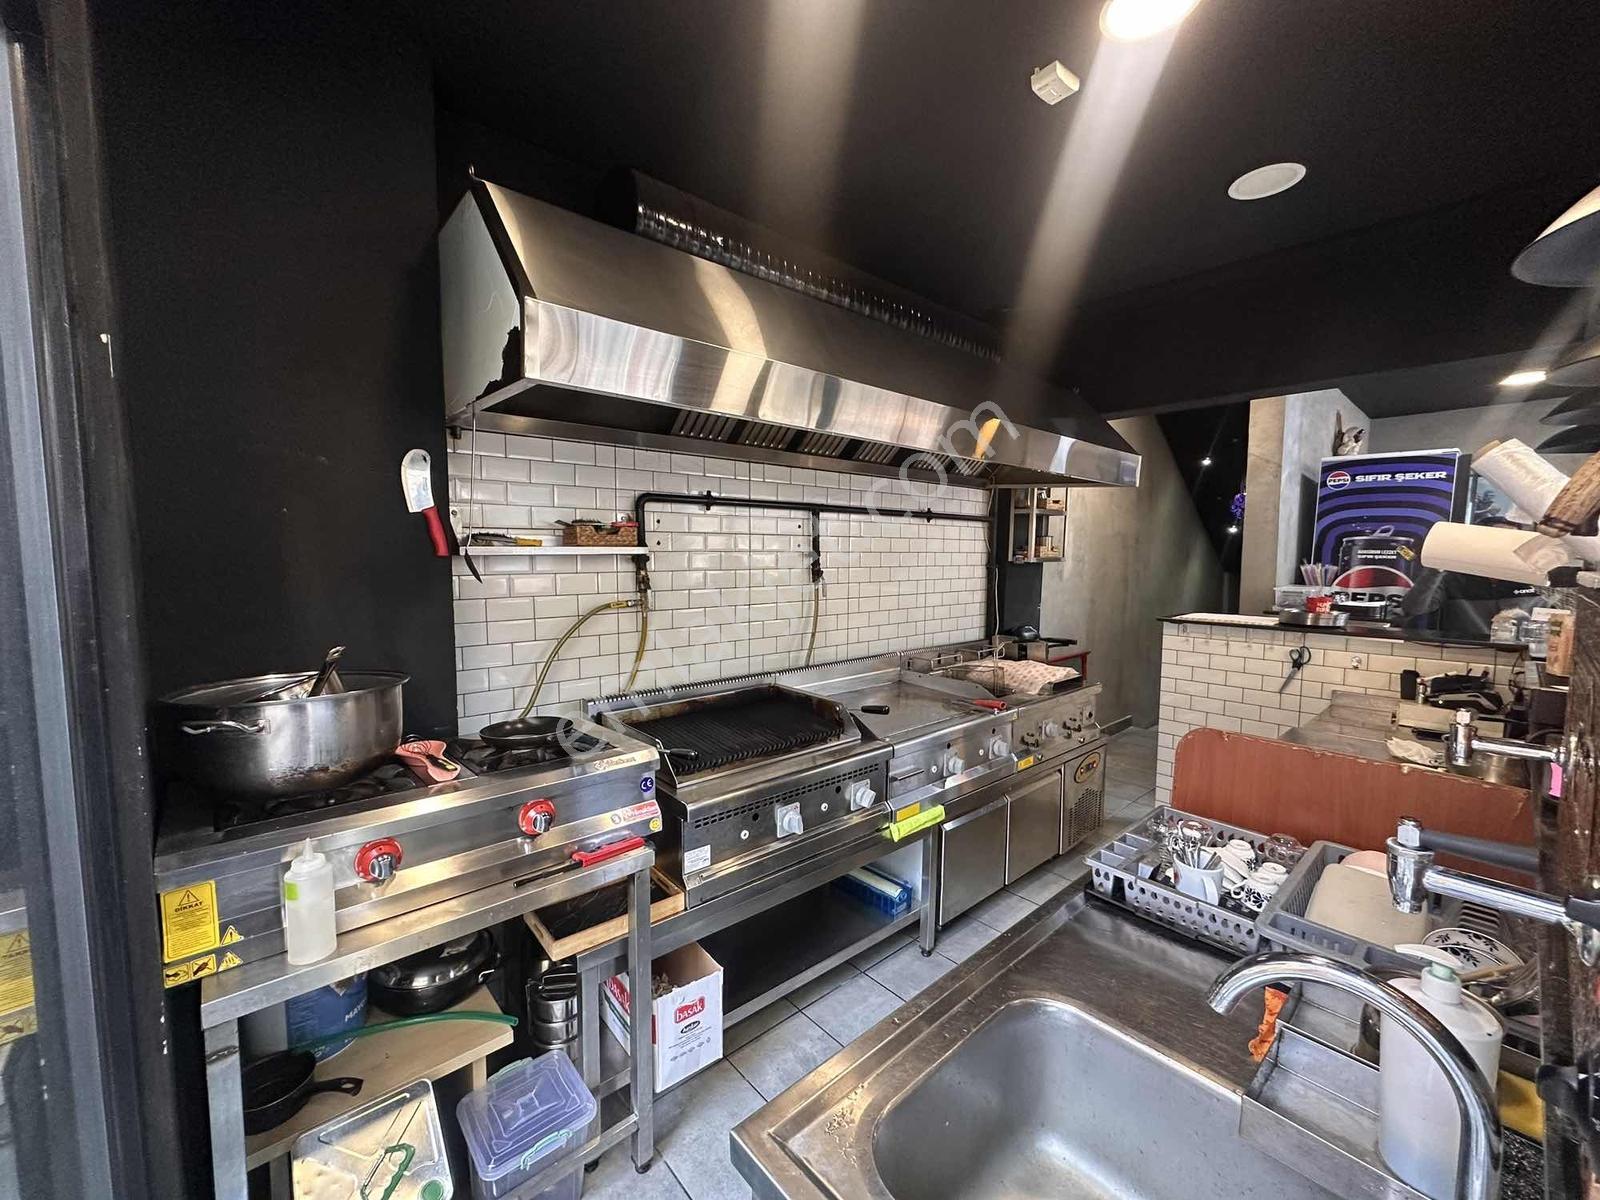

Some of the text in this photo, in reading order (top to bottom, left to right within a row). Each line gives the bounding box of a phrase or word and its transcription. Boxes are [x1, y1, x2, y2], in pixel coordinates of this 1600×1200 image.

[1355, 471, 1447, 483] SIFIR ŞEKER
[641, 778, 653, 790] CE
